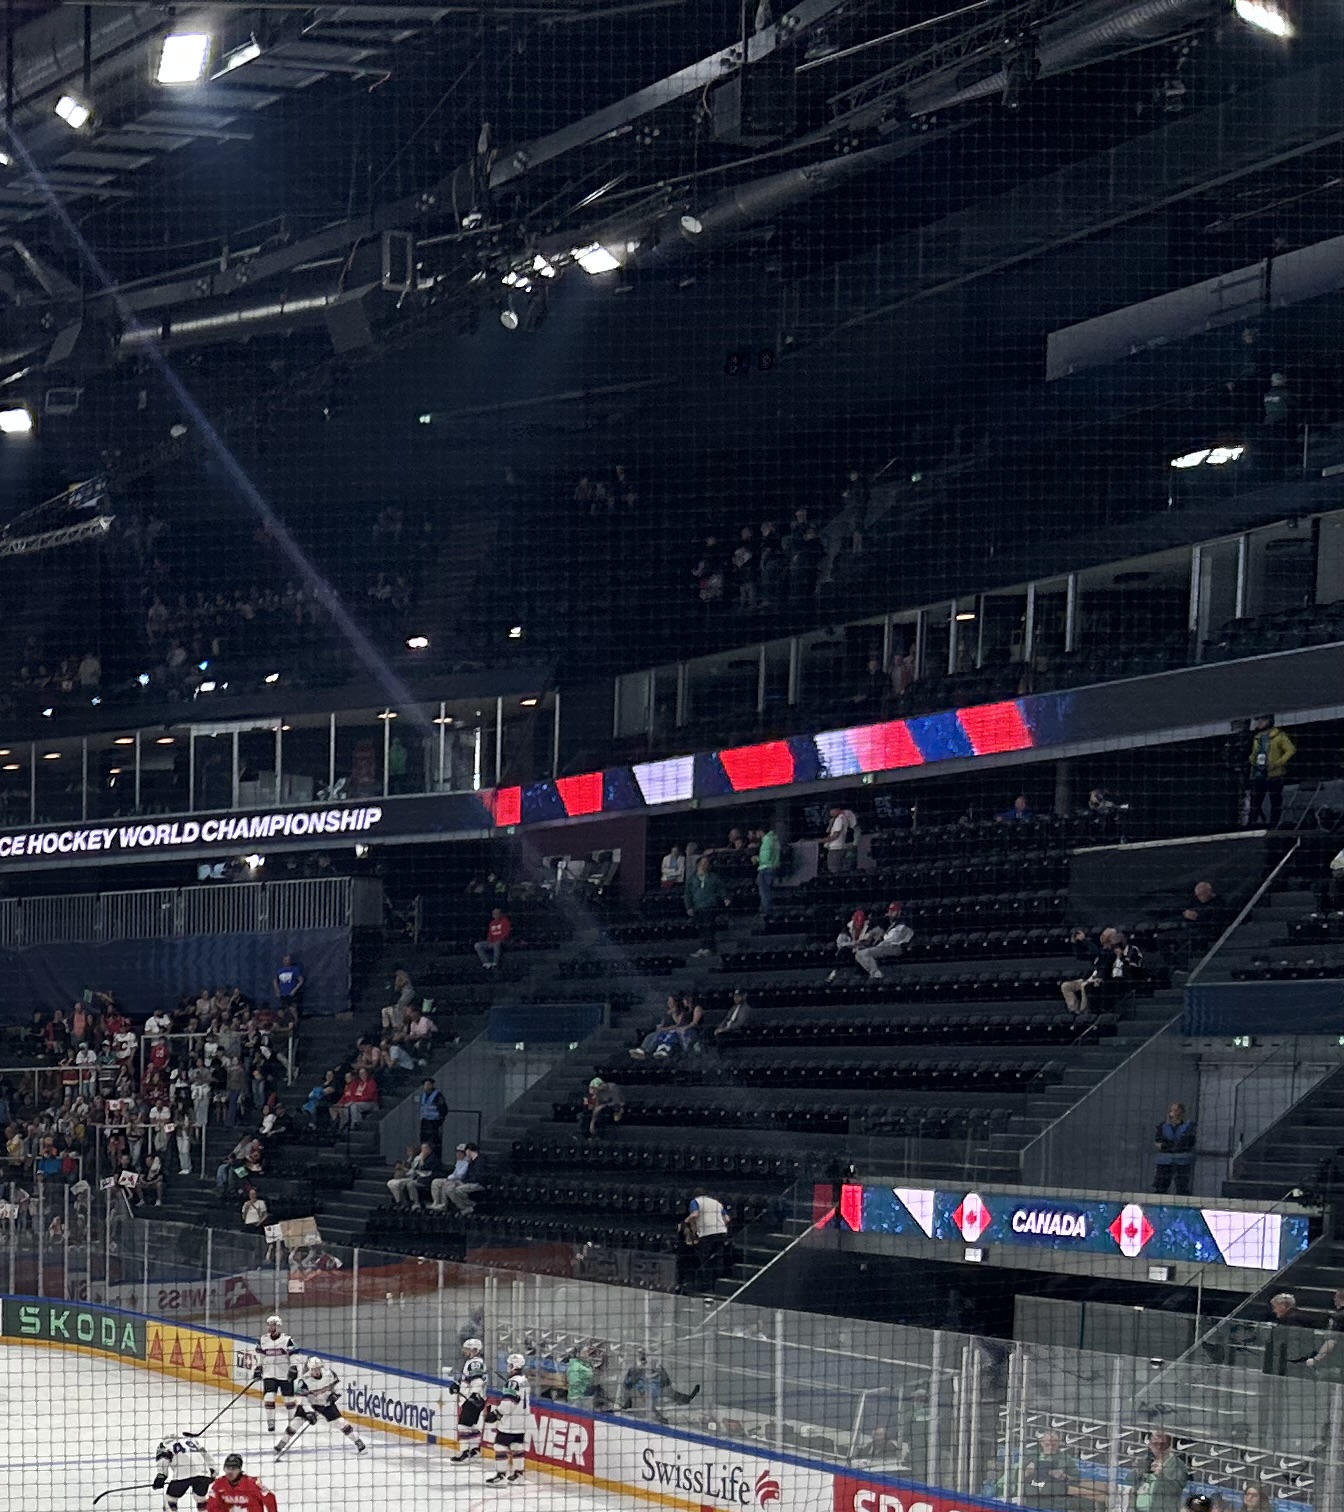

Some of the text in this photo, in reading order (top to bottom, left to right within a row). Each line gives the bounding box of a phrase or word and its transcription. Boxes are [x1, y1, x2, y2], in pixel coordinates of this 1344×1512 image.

[27, 827, 117, 856] HOCKEY
[118, 820, 200, 848] WORLD
[200, 805, 383, 844] CHAMPIONSHIP
[1011, 1208, 1087, 1239] CANADA
[346, 1380, 436, 1436] ticketcorner
